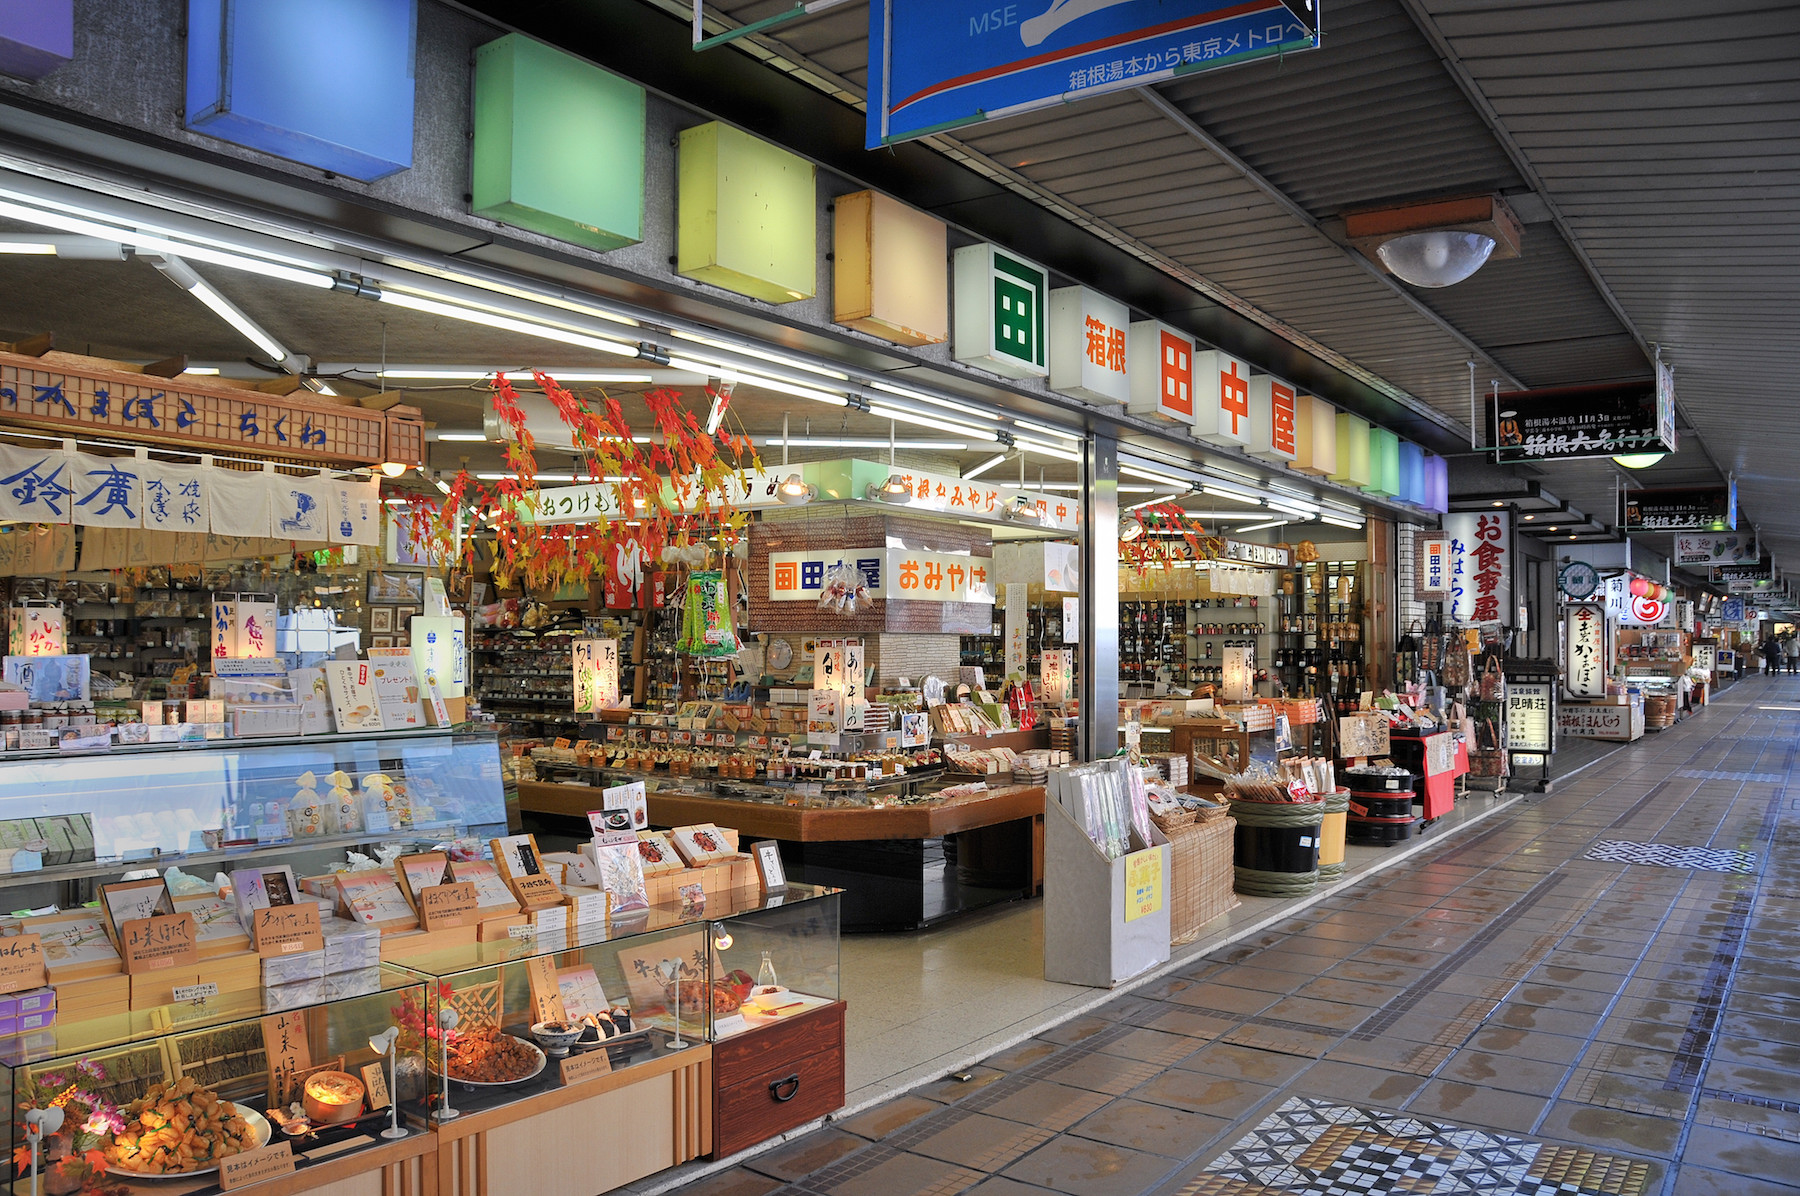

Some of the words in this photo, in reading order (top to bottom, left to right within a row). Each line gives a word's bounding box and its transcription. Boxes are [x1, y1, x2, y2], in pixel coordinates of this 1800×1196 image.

[968, 4, 1018, 37] MSE
[1068, 21, 1308, 91] 箱根湯本から東京メトロへ
[1085, 313, 1127, 375] 箱根
[0, 456, 139, 520] 鈴廣
[899, 559, 987, 592] おみやげ
[1429, 555, 1441, 587] 田中屋
[1610, 579, 1623, 610] 菊川
[1509, 697, 1547, 711] 見晴荘
[1510, 687, 1541, 695] 温泉旅館
[1586, 714, 1621, 728] まんじゅう
[1514, 755, 1543, 765] 空室あり
[129, 918, 190, 948] 山菜ほたて
[226, 1149, 290, 1175] 見本はイメージです。
